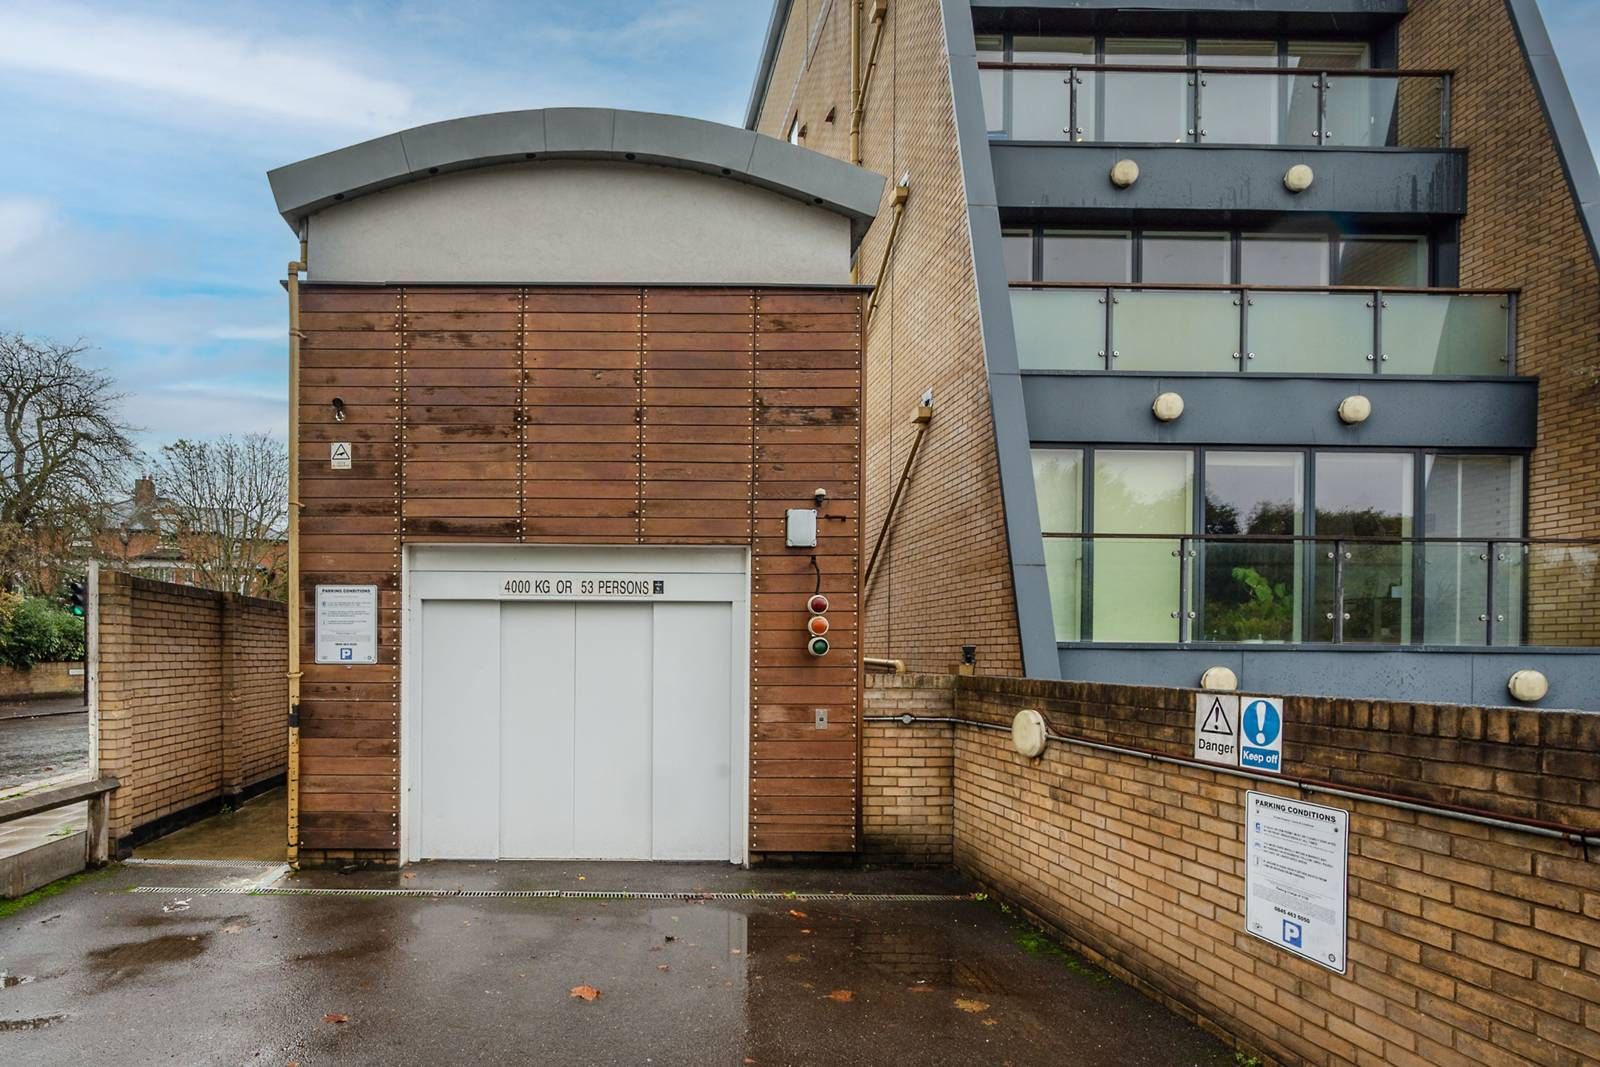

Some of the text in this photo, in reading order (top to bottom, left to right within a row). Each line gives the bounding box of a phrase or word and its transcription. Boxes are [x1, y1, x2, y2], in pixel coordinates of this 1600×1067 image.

[504, 580, 650, 594] 4000 KG OR 53 PERSONS
[1198, 738, 1235, 755] Danger
[1243, 750, 1279, 764] Keep off
[1255, 799, 1286, 812] PARKING
[1287, 806, 1337, 823] CONDITIONS
